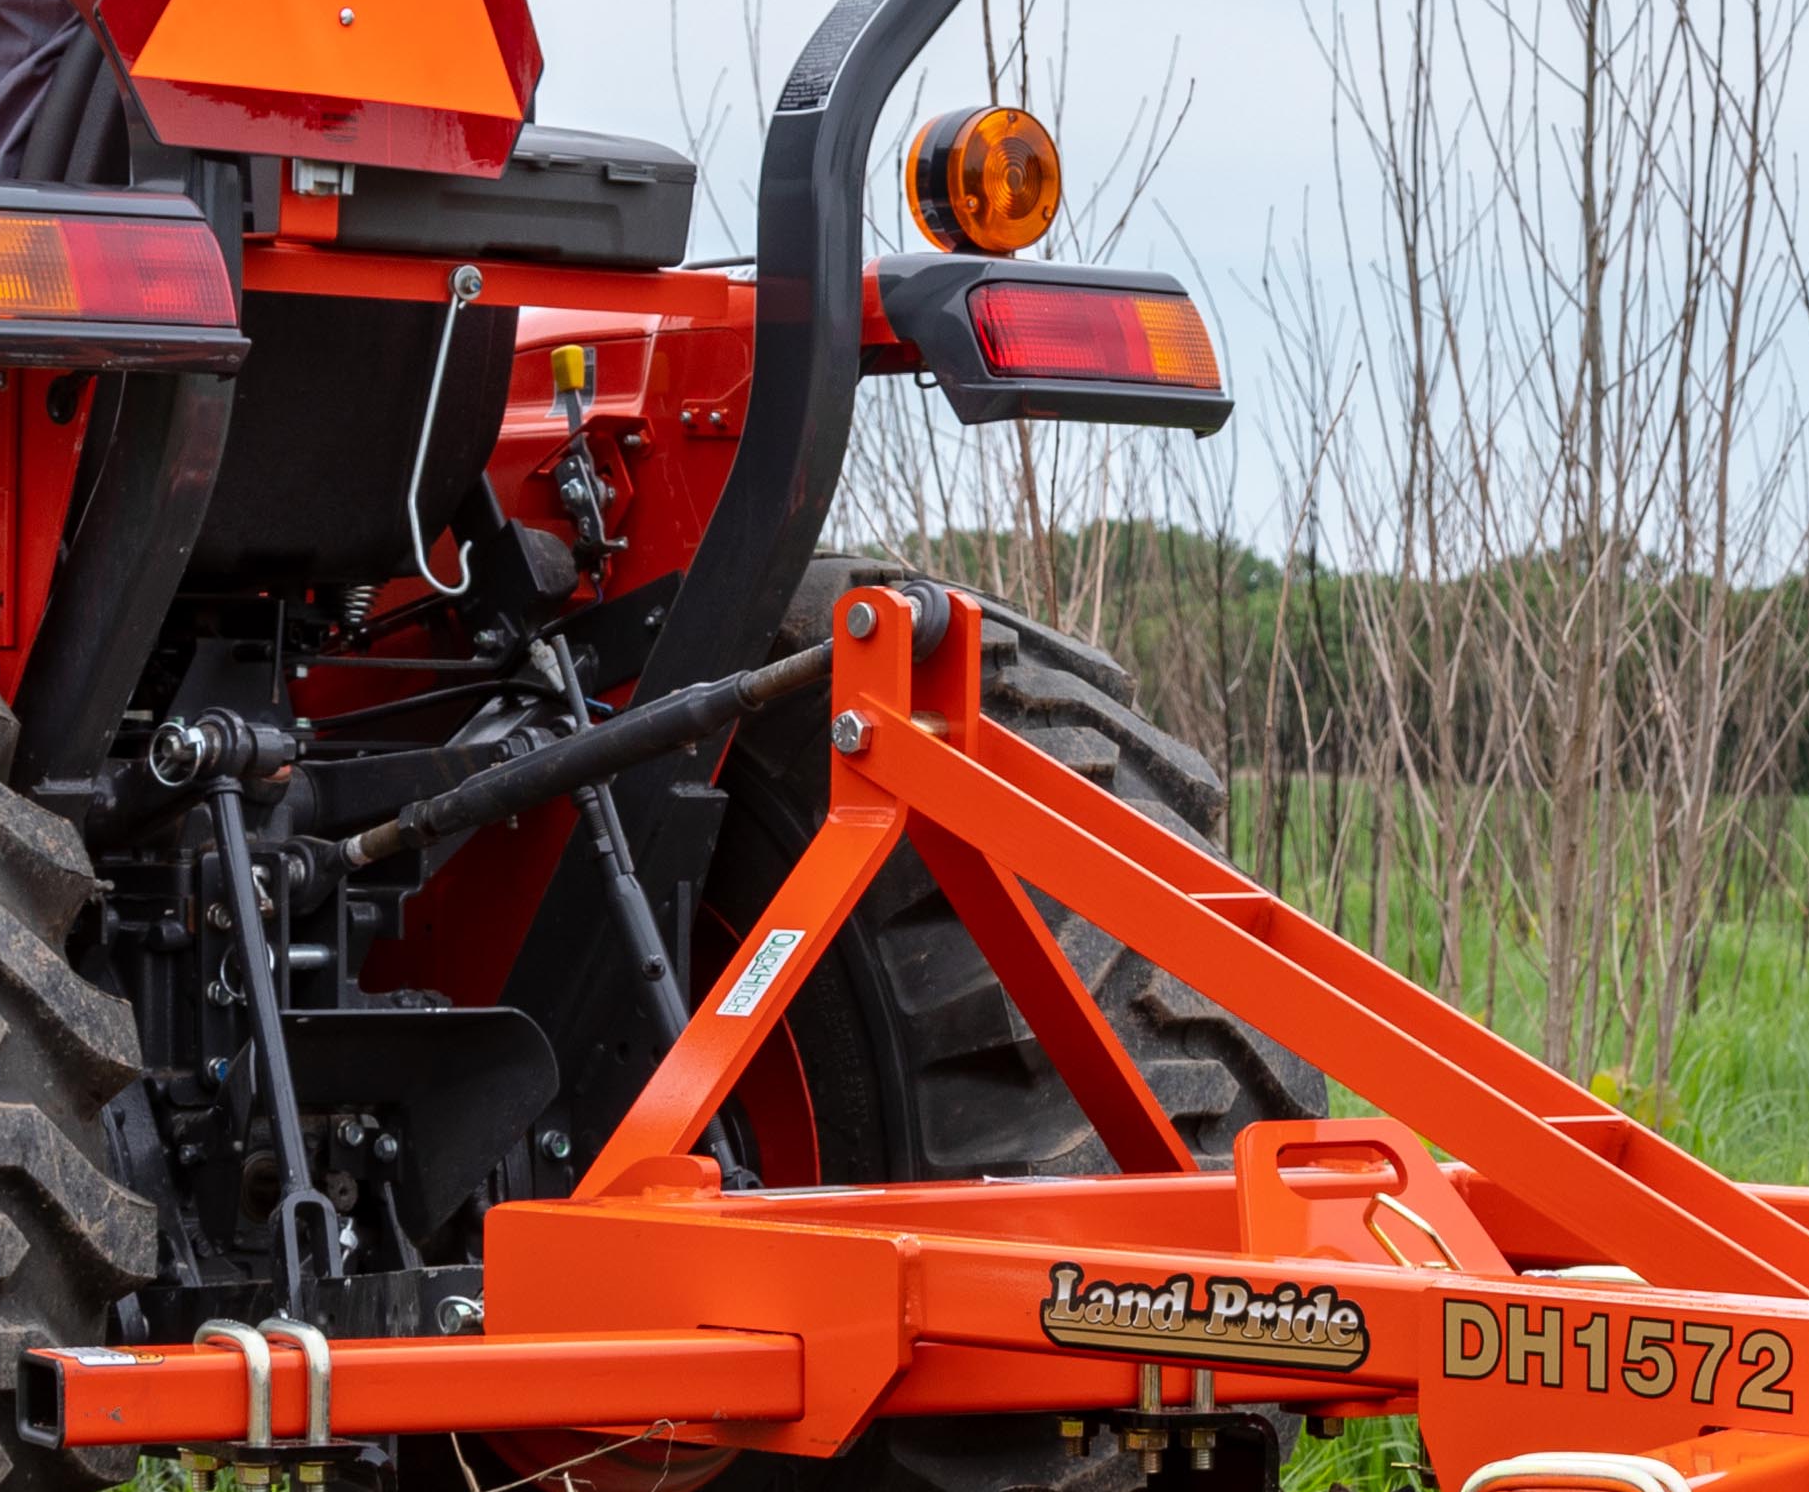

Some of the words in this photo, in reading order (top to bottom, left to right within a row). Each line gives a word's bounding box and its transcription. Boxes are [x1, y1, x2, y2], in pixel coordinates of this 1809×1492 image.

[1049, 1264, 1189, 1335] Land
[1203, 1277, 1363, 1347] Pride
[1443, 1300, 1793, 1415] DH1572
